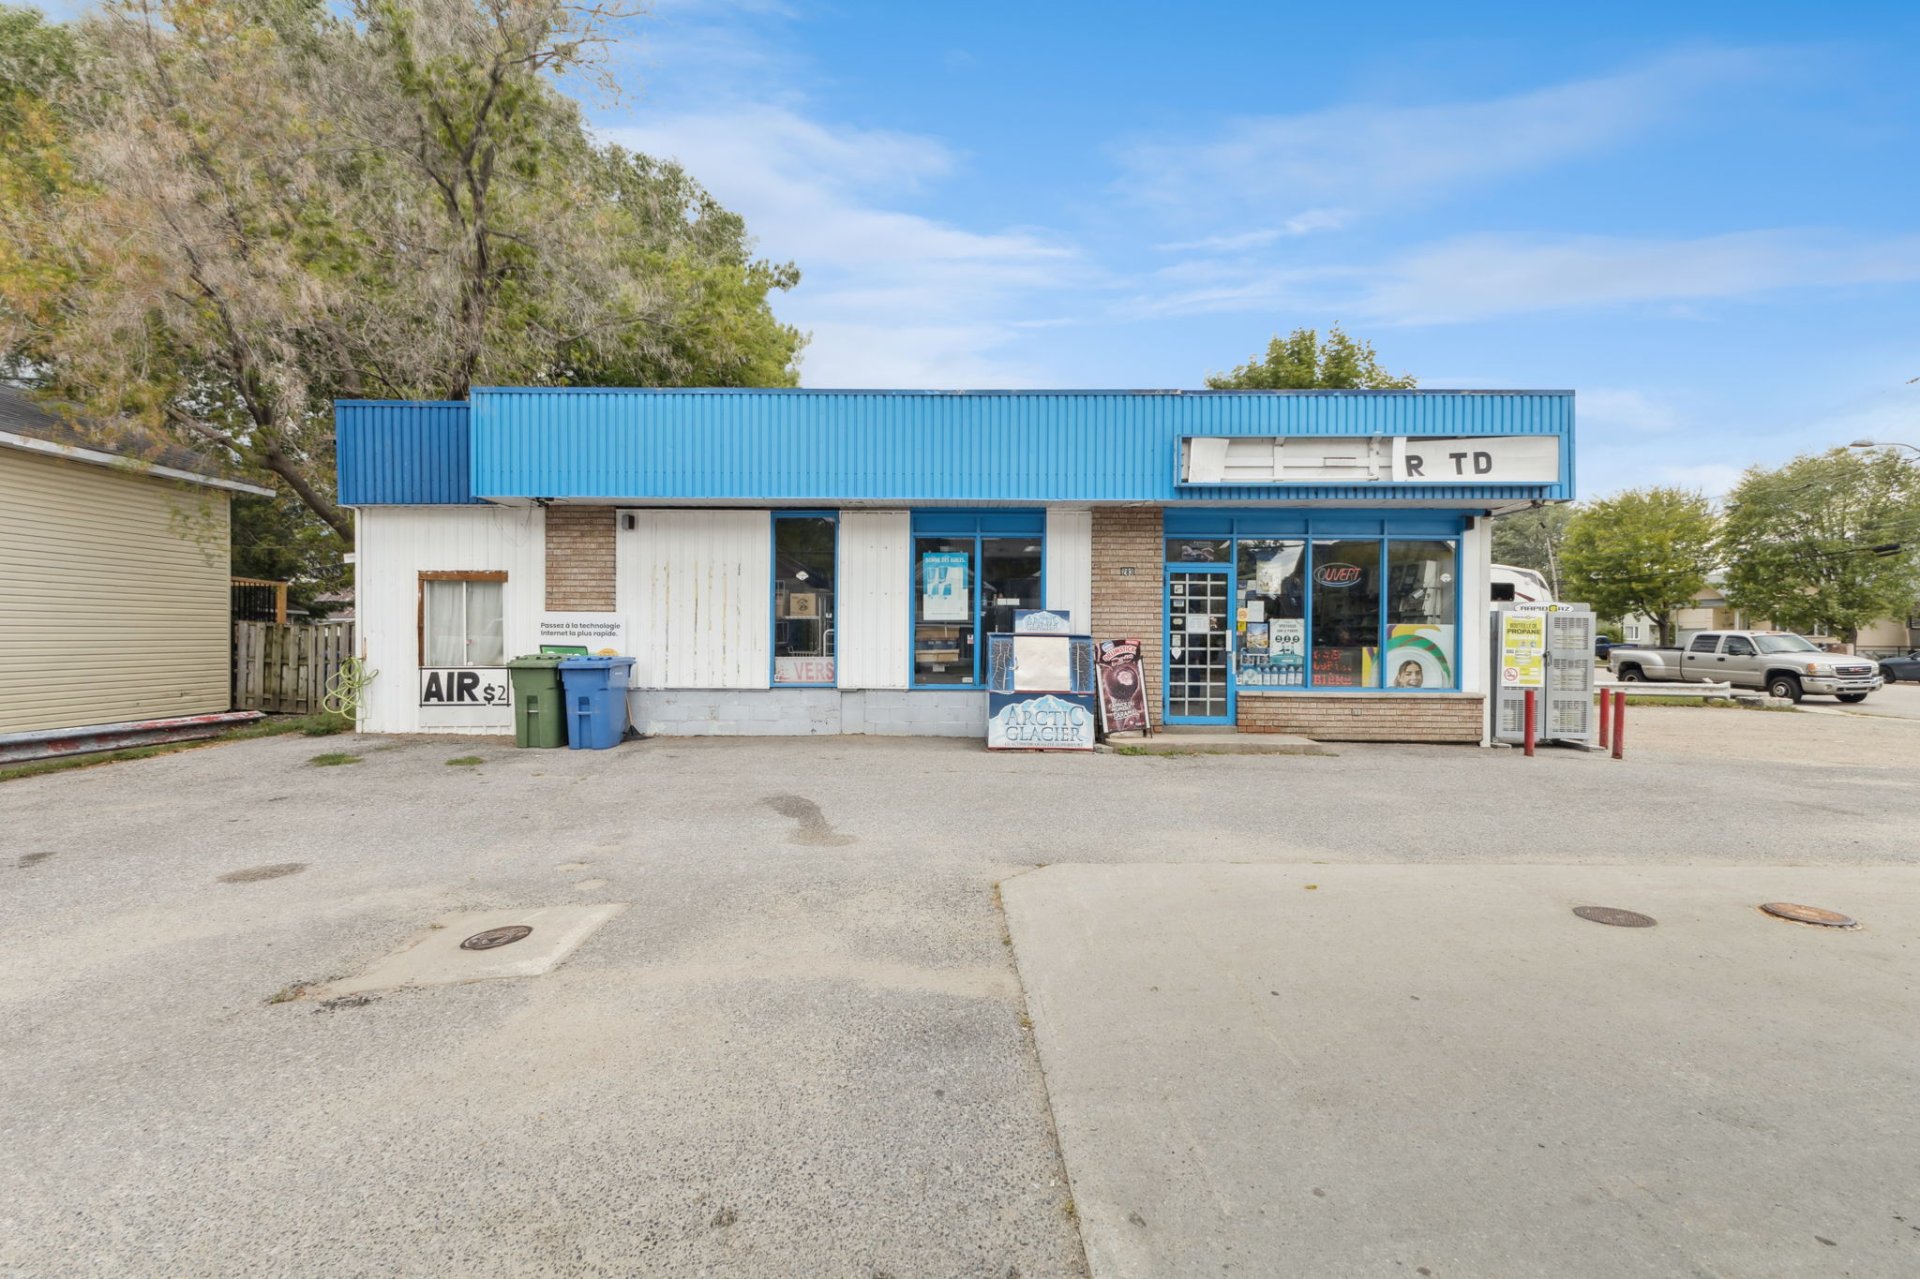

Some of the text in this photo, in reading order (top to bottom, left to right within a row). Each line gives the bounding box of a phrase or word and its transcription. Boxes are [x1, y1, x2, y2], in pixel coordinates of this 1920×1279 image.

[1405, 455, 1425, 477] R
[1317, 567, 1361, 581] OUVERT
[577, 630, 592, 638] plus
[579, 622, 621, 631] technologie
[423, 671, 506, 705] AIR $2
[1004, 704, 1085, 727] ARCTIC
[1005, 725, 1083, 742] GLACIER
